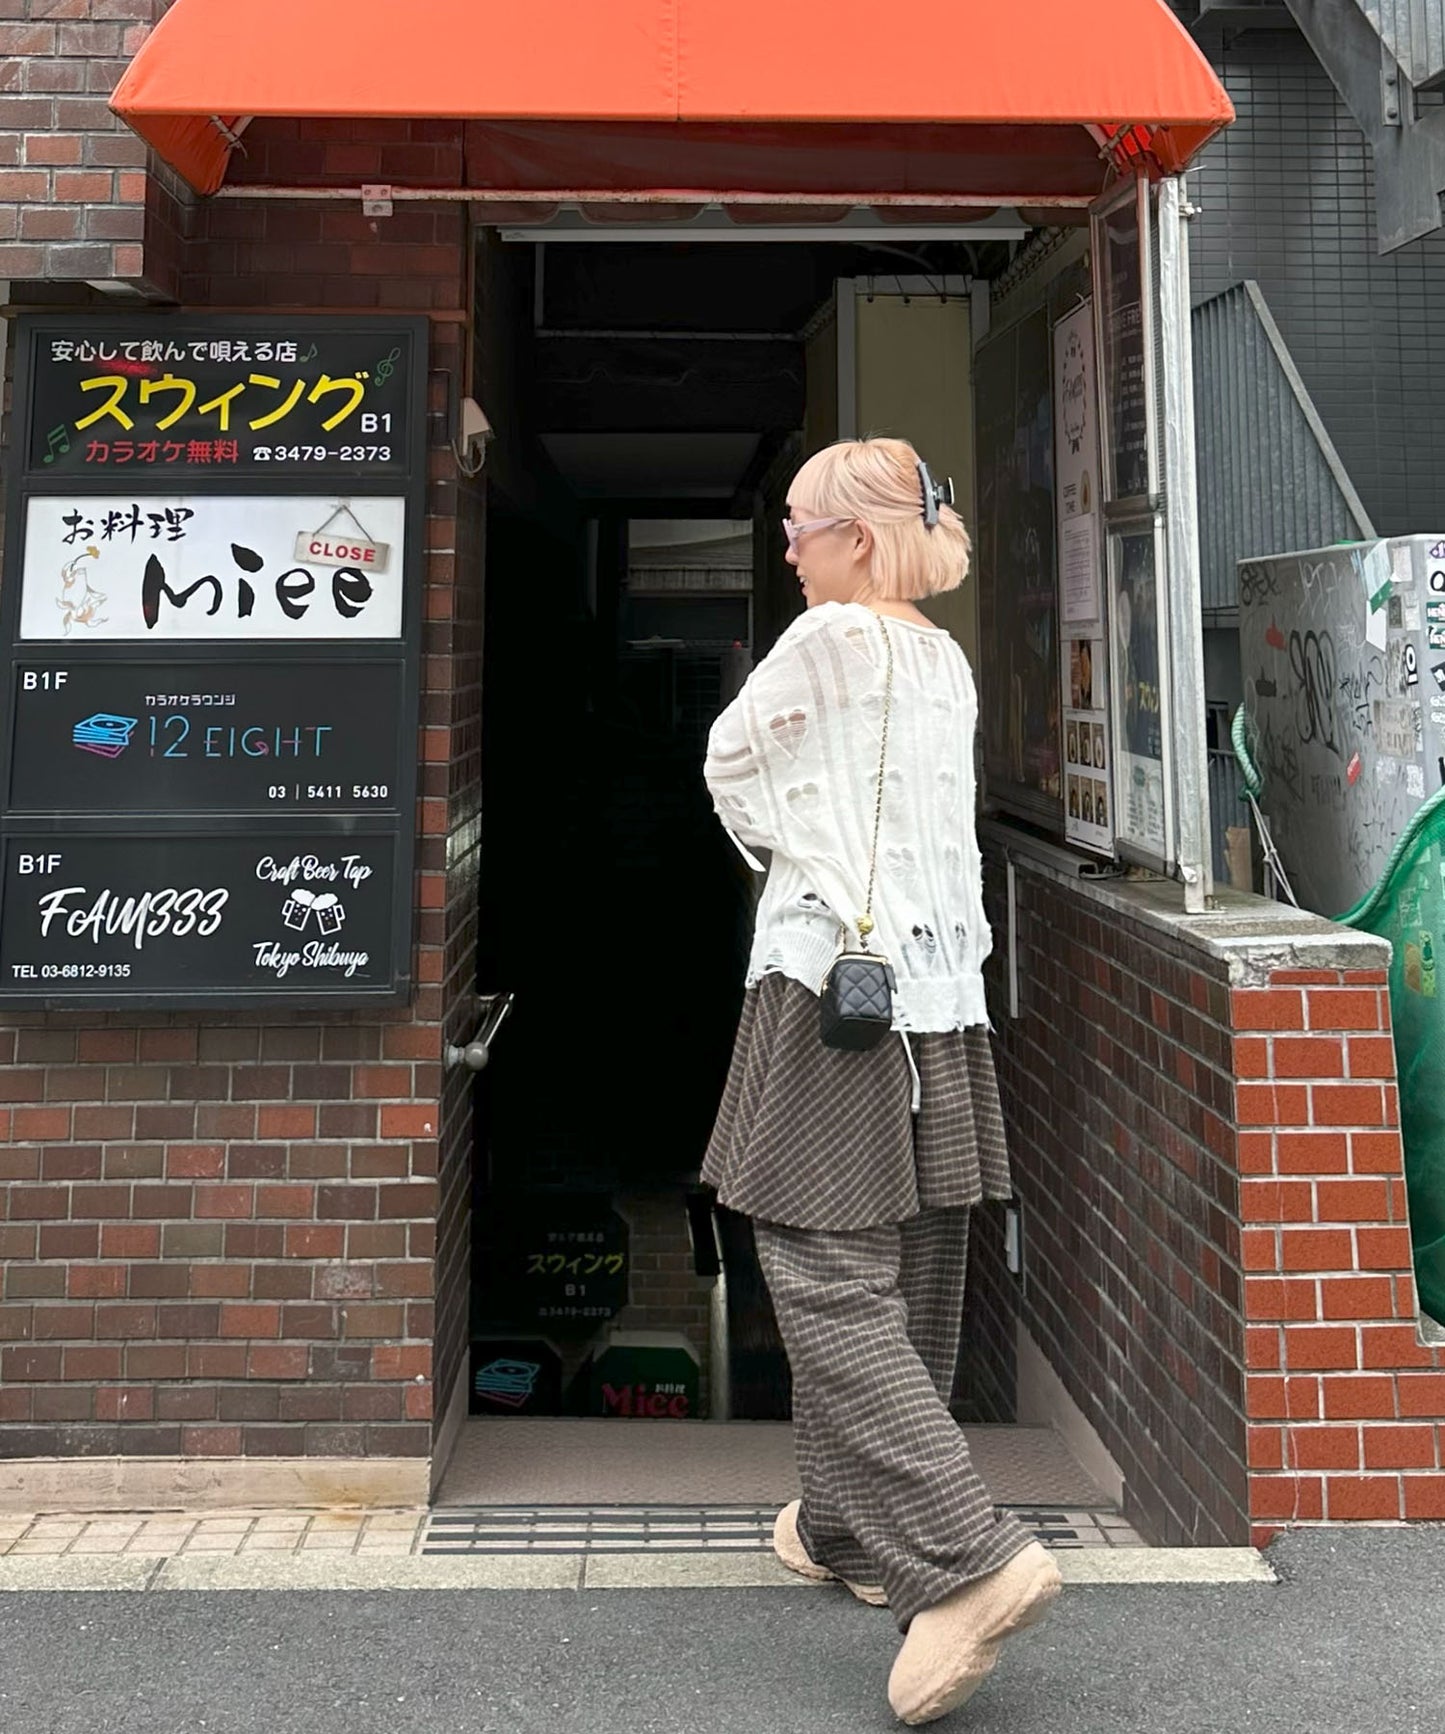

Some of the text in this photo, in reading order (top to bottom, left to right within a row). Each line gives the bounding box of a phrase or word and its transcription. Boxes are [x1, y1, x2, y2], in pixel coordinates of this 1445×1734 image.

[51, 339, 298, 363] 安心して飲んで唄える店
[75, 371, 369, 432] スウィング
[361, 413, 392, 433] B1
[85, 439, 239, 464] カラオケ無料
[61, 503, 194, 544] お料理
[309, 541, 377, 563] CLOSE
[22, 671, 68, 690] B1F
[145, 694, 236, 706] カラオケラウンジ
[149, 715, 333, 757] 12 EIGHT
[268, 785, 286, 798] 03
[307, 785, 341, 798] 5411
[352, 785, 388, 798] 5630
[18, 855, 62, 874] B1F
[256, 854, 373, 889] Craft Beer Tap
[252, 940, 370, 978] Tokyo Shibuya
[12, 964, 131, 978] TEL 03-6812-9135
[526, 1252, 625, 1275] スウィング
[564, 1283, 586, 1297] B1
